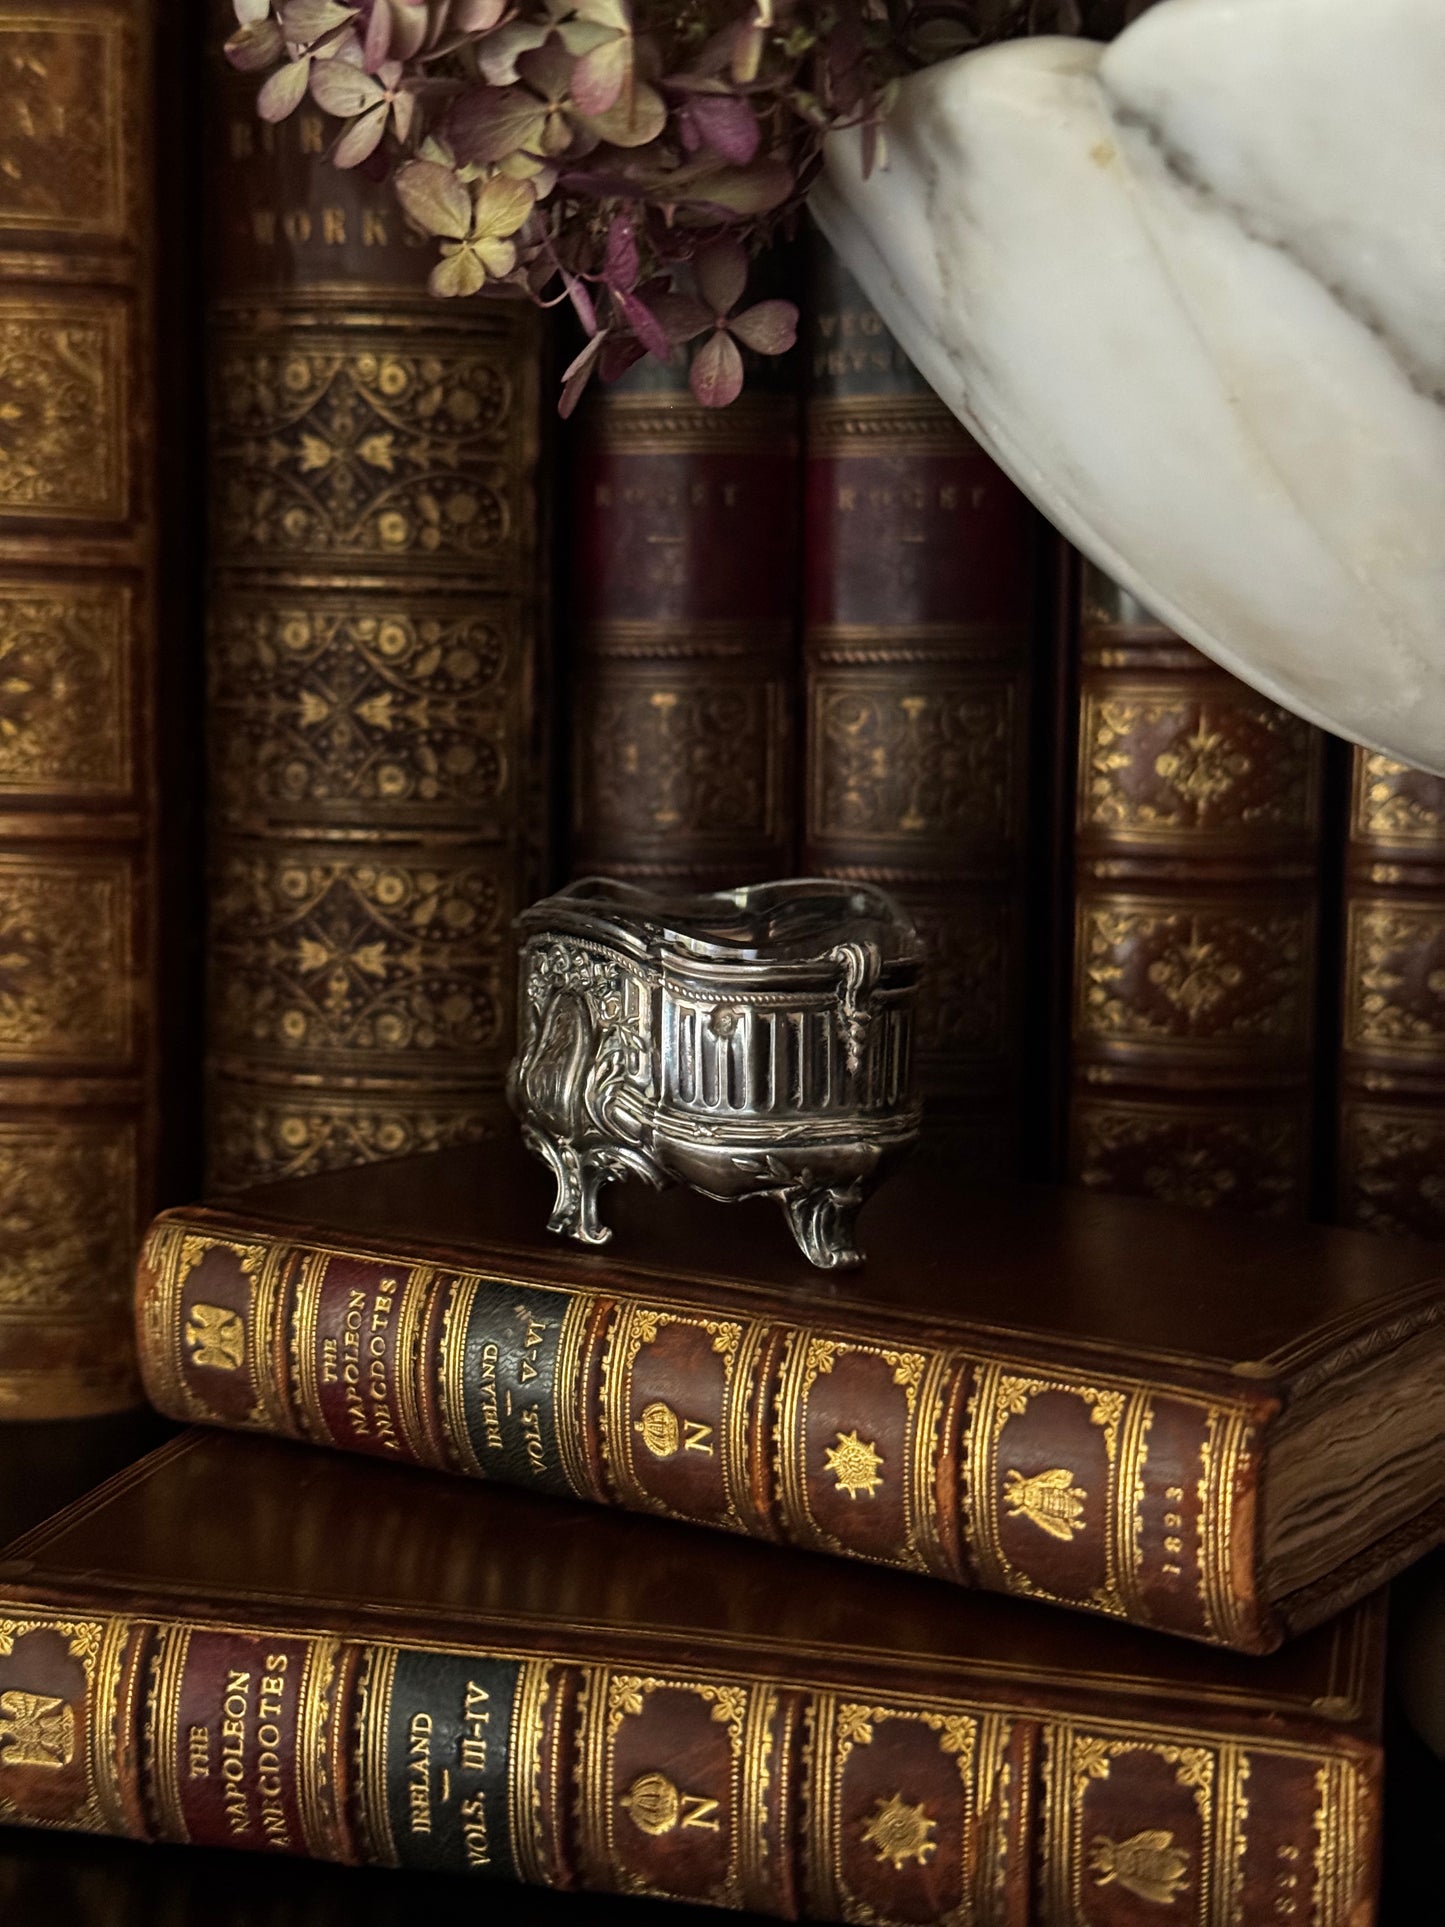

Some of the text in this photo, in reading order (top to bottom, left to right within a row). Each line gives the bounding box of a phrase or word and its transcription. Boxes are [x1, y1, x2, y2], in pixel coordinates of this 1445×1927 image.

[323, 1339, 338, 1384] THE
[344, 1288, 370, 1435] NAPOLEON
[369, 1278, 401, 1451] ANECDOTES
[481, 1343, 504, 1449] IRELAND
[521, 1318, 549, 1476] VOLS. V-VI
[684, 1419, 714, 1456] N
[189, 1726, 210, 1780] THE
[223, 1669, 252, 1835] NAPOLEON
[258, 1653, 290, 1849] ANECDOTES
[408, 1712, 433, 1835] IRELAND
[461, 1680, 492, 1867] VOLS. III-IV
[681, 1793, 720, 1832] N
